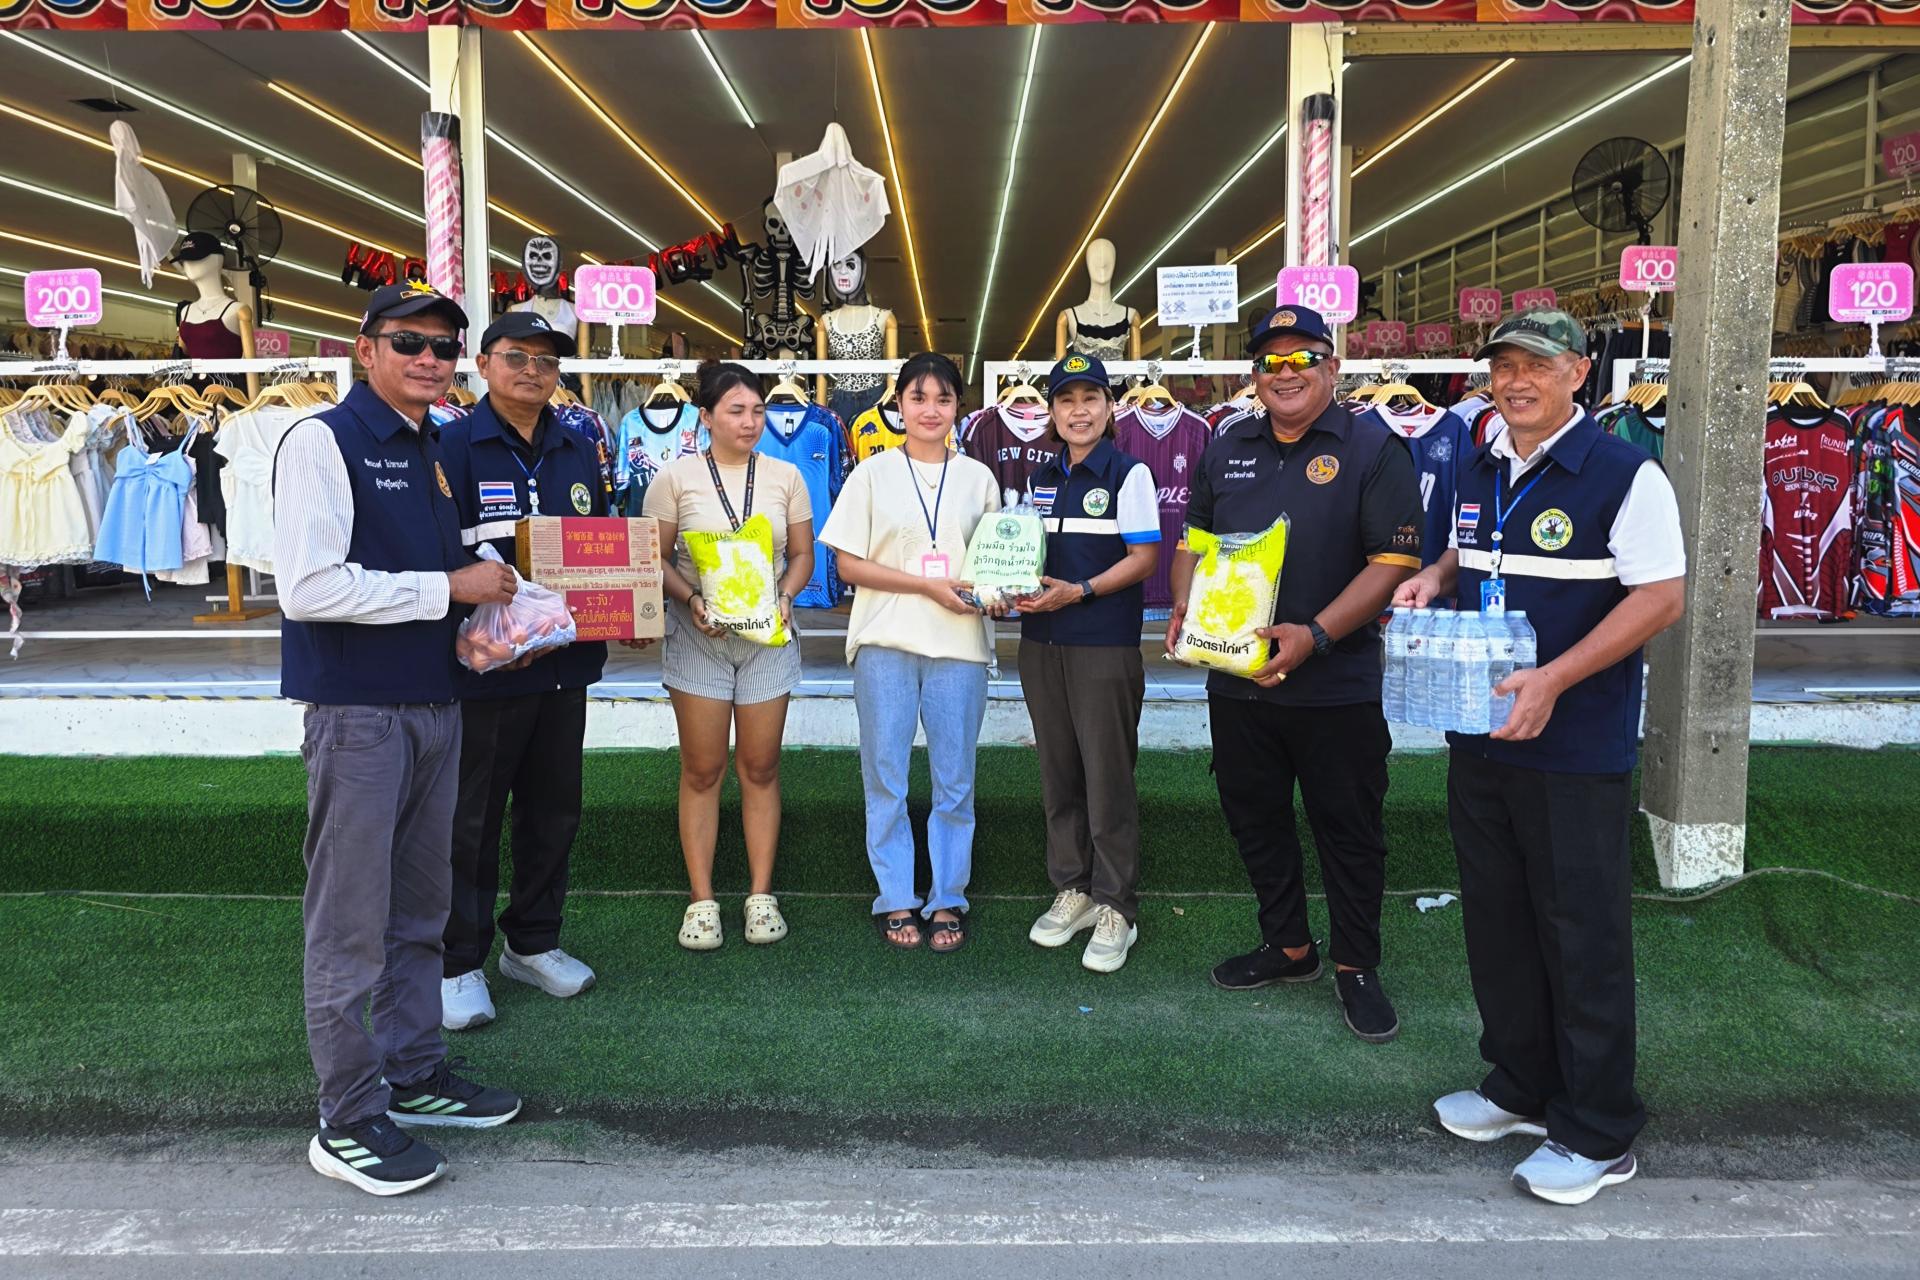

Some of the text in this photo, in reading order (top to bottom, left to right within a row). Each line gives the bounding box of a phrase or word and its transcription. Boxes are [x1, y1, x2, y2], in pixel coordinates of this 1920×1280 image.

[1892, 143, 1917, 166] 120
[600, 272, 632, 283] SALE
[1303, 271, 1336, 283] SALE
[1634, 258, 1675, 281] 100
[37, 285, 91, 313] 200
[592, 282, 645, 310] 100
[1295, 283, 1341, 310] 180
[1850, 280, 1897, 308] 120
[1468, 297, 1496, 314] 100
[1376, 329, 1401, 342] 100
[1423, 332, 1447, 345] 100
[255, 338, 281, 352] 120
[1026, 448, 1058, 464] CIT
[977, 540, 1036, 553] ร่วมมือ ร่วมใจ
[1186, 633, 1250, 655] ข้าวตราไก่แจ้
